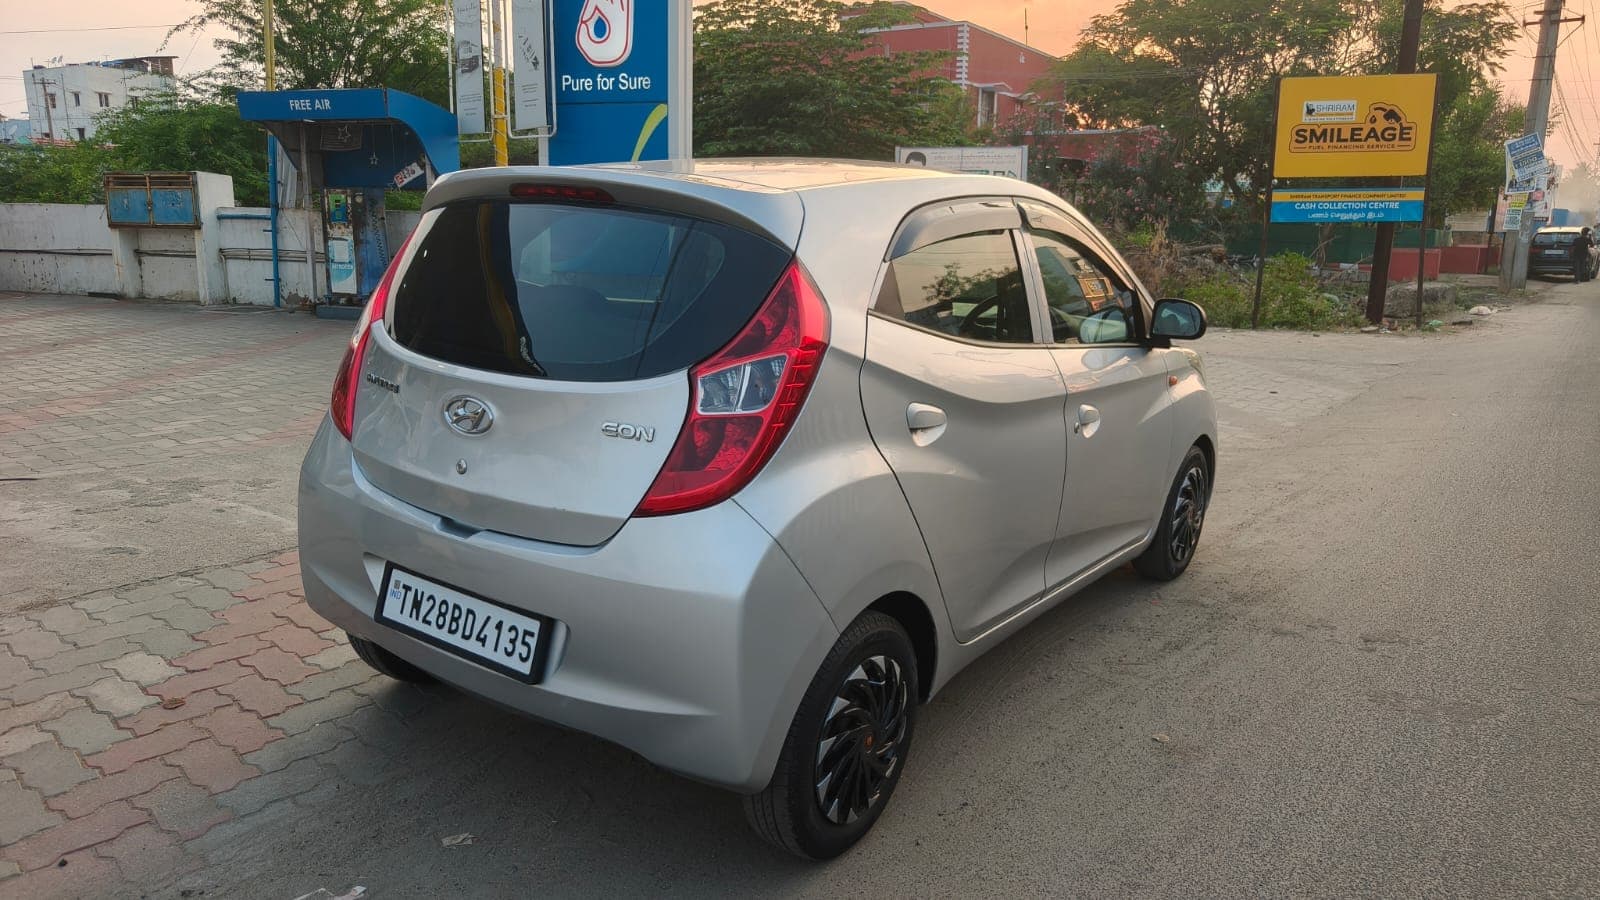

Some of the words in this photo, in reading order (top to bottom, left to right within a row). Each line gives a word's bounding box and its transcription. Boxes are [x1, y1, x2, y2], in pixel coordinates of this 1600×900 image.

[562, 75, 593, 92] Pure
[597, 74, 614, 90] for
[618, 73, 651, 90] Sure
[289, 99, 312, 111] FREE
[315, 99, 332, 110] AIR
[1316, 103, 1355, 112] SHRIRAM
[1295, 126, 1413, 144] SMILEAGE
[1295, 202, 1316, 210] CASH
[1369, 201, 1400, 209] CENTRE
[601, 421, 656, 443] EON
[390, 589, 401, 600] IND
[399, 583, 536, 664] TN28BD4135
